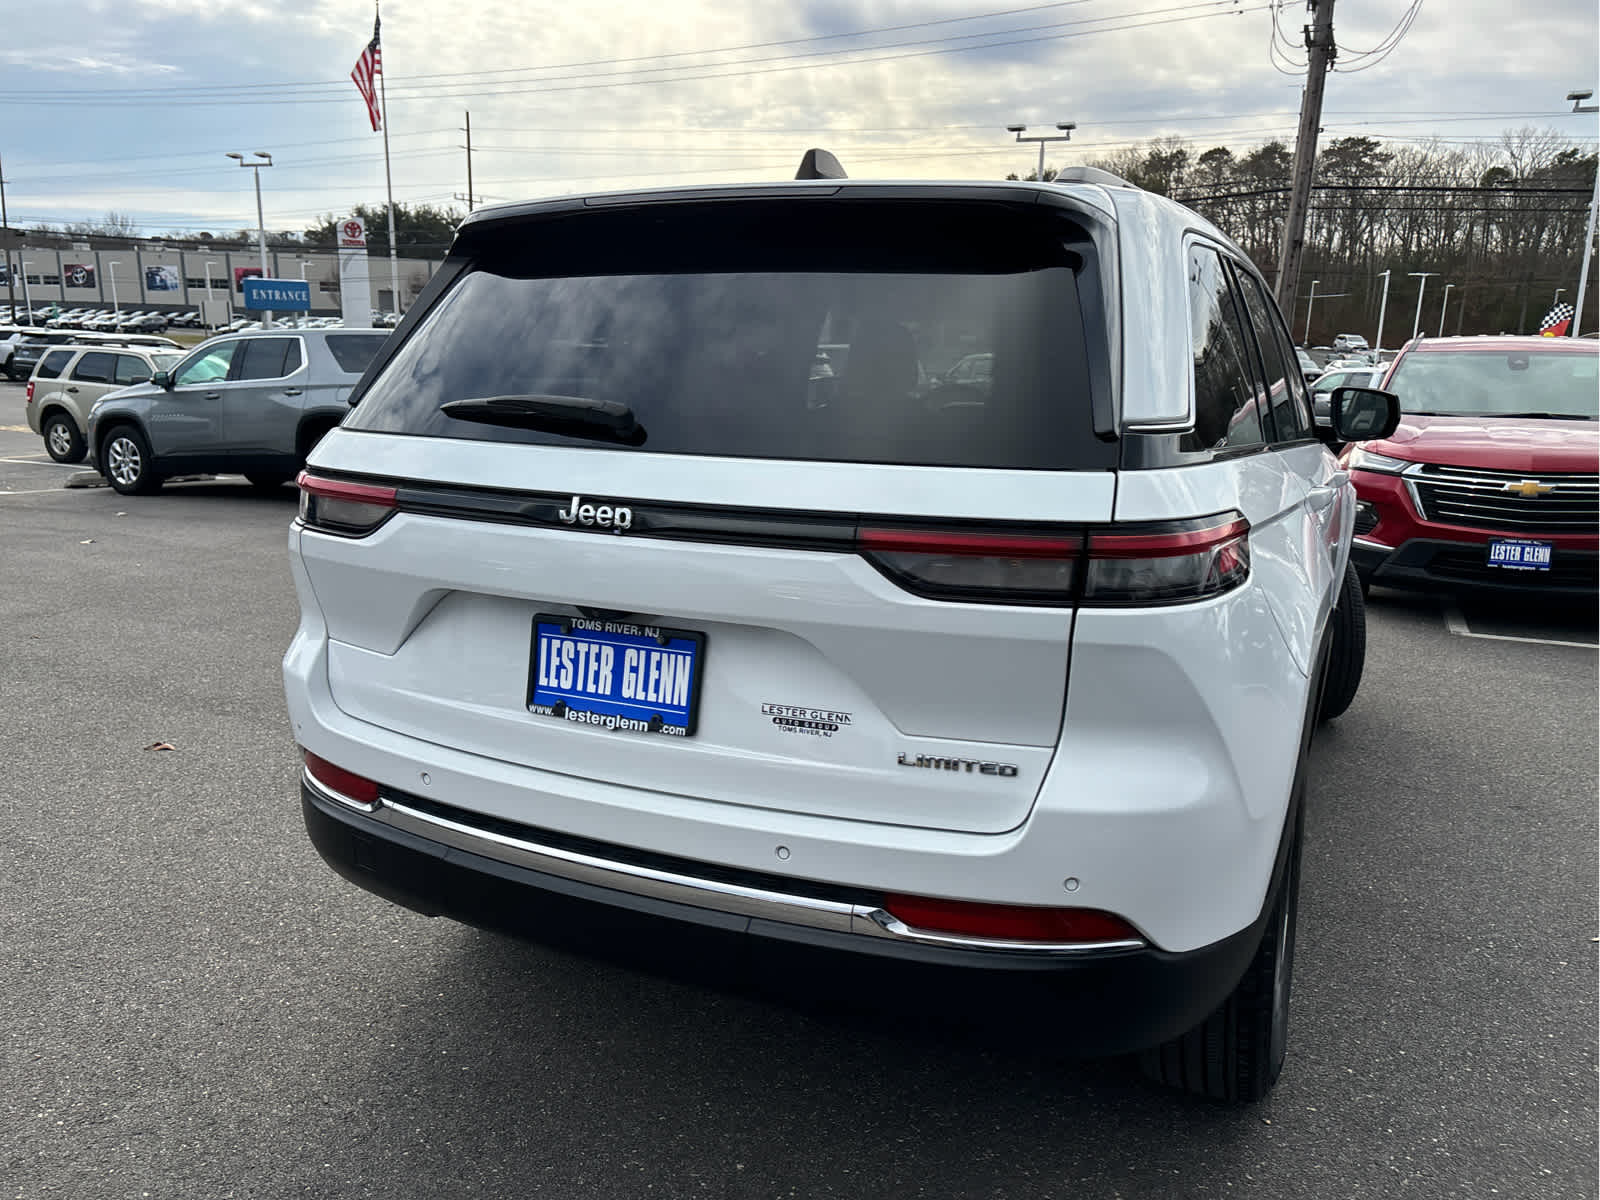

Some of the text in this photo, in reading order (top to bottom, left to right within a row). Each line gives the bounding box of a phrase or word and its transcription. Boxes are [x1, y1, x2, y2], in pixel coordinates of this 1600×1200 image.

[252, 289, 308, 302] ENTRANCE
[559, 496, 632, 533] Jeep
[1490, 543, 1551, 563] LESTER GLENN
[571, 618, 660, 638] TOMS RIVER, NJ
[538, 637, 691, 707] LESTER GLENN
[761, 704, 807, 718] LESTER
[775, 717, 838, 731] AUTO GROUP
[897, 752, 1018, 777] LIMITED
